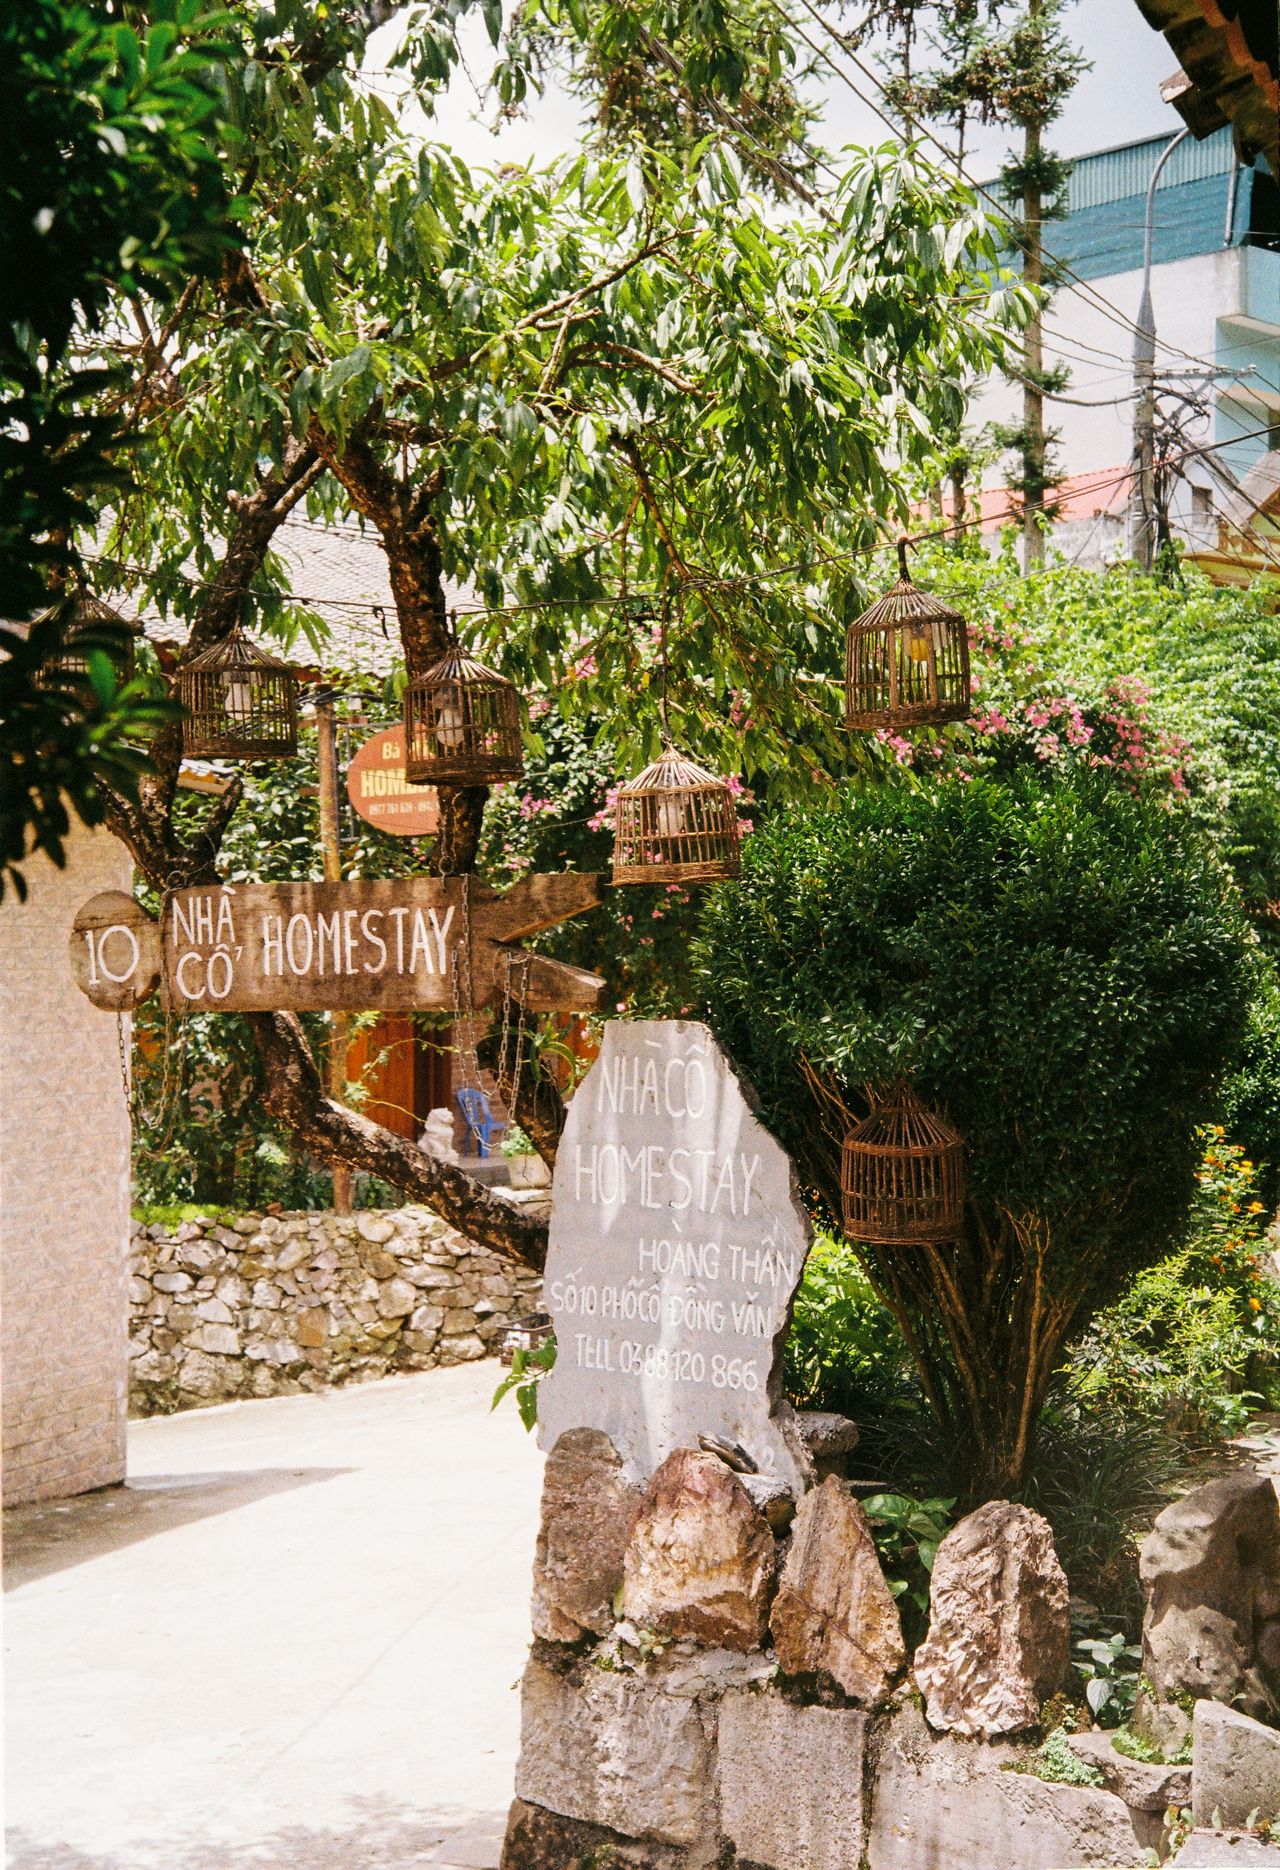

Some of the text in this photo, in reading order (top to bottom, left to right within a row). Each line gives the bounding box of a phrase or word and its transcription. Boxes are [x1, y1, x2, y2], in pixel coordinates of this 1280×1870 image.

[172, 885, 237, 947] NHÀ
[263, 906, 456, 977] HOMESTAY
[85, 924, 140, 985] 10
[575, 1144, 760, 1216] HOMESTAY
[711, 1354, 759, 1392] 866
